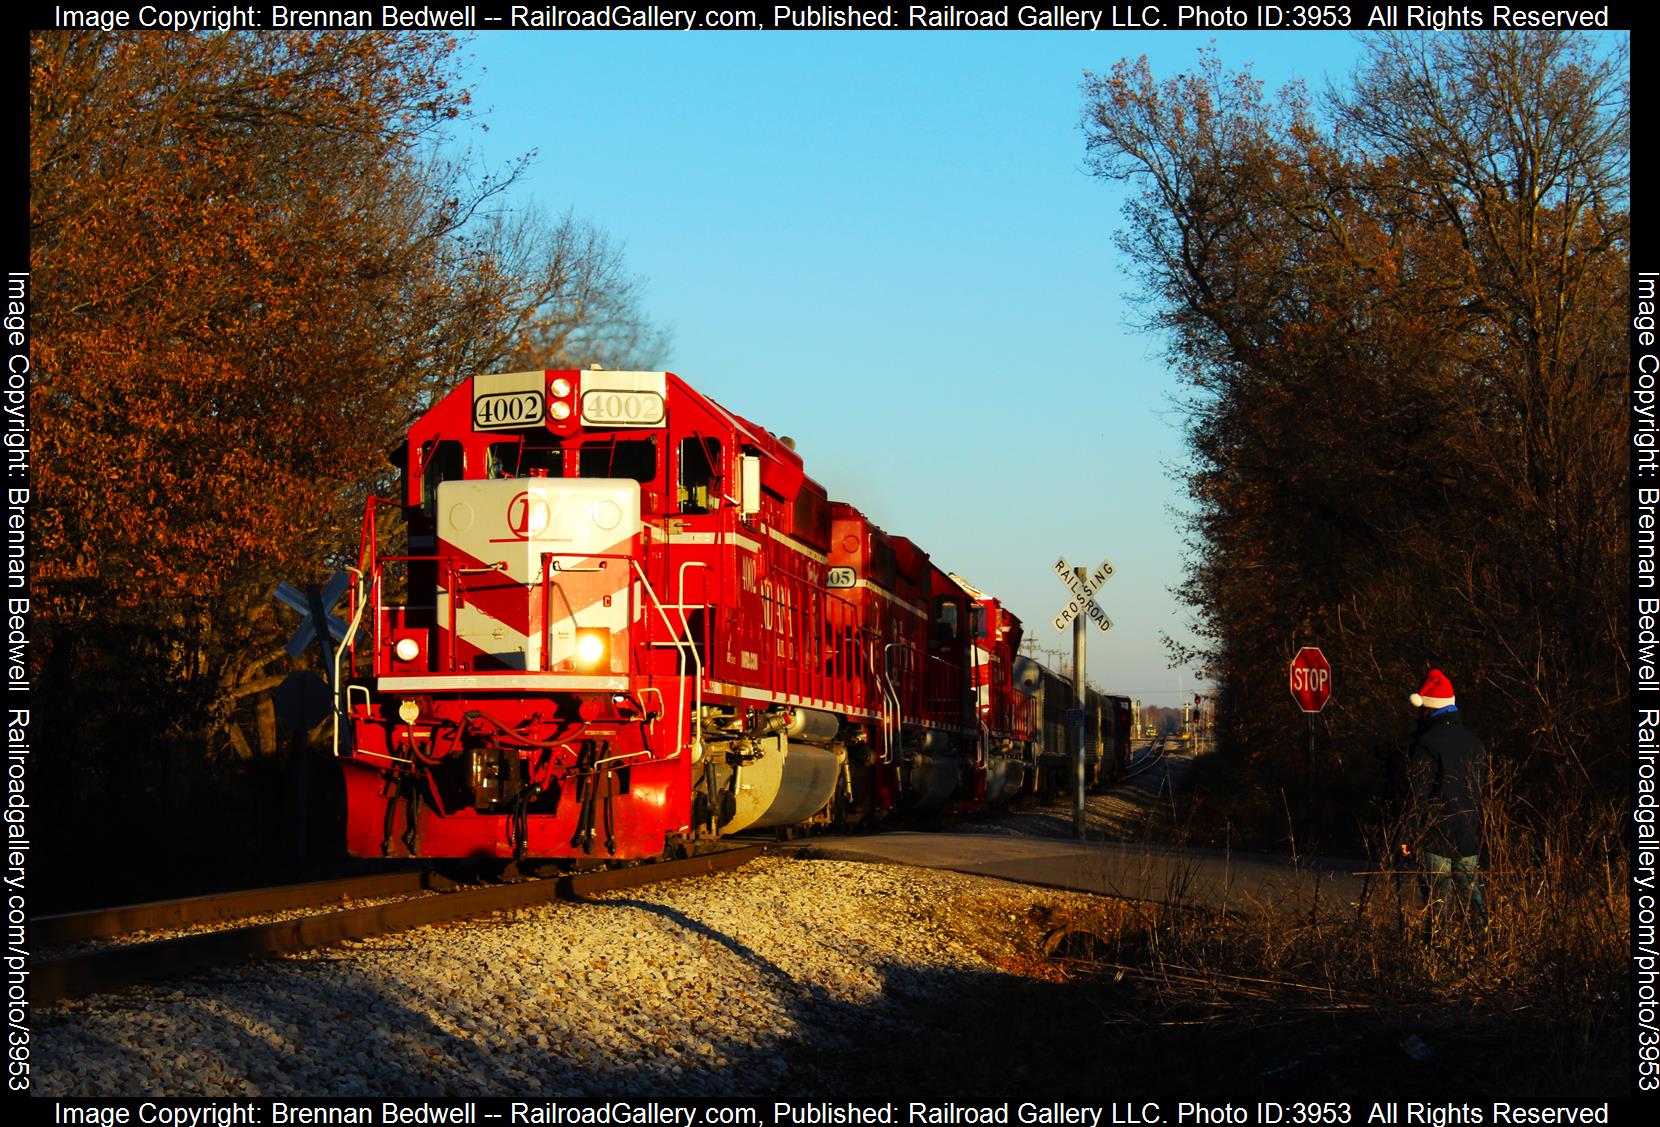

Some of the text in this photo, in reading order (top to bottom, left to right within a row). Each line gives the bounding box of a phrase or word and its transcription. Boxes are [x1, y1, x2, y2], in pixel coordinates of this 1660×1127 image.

[478, 396, 538, 422] 4002
[587, 395, 659, 418] 4002
[826, 571, 850, 585] 05
[1055, 563, 1113, 630] CROSSING
[1294, 667, 1328, 692] STOP
